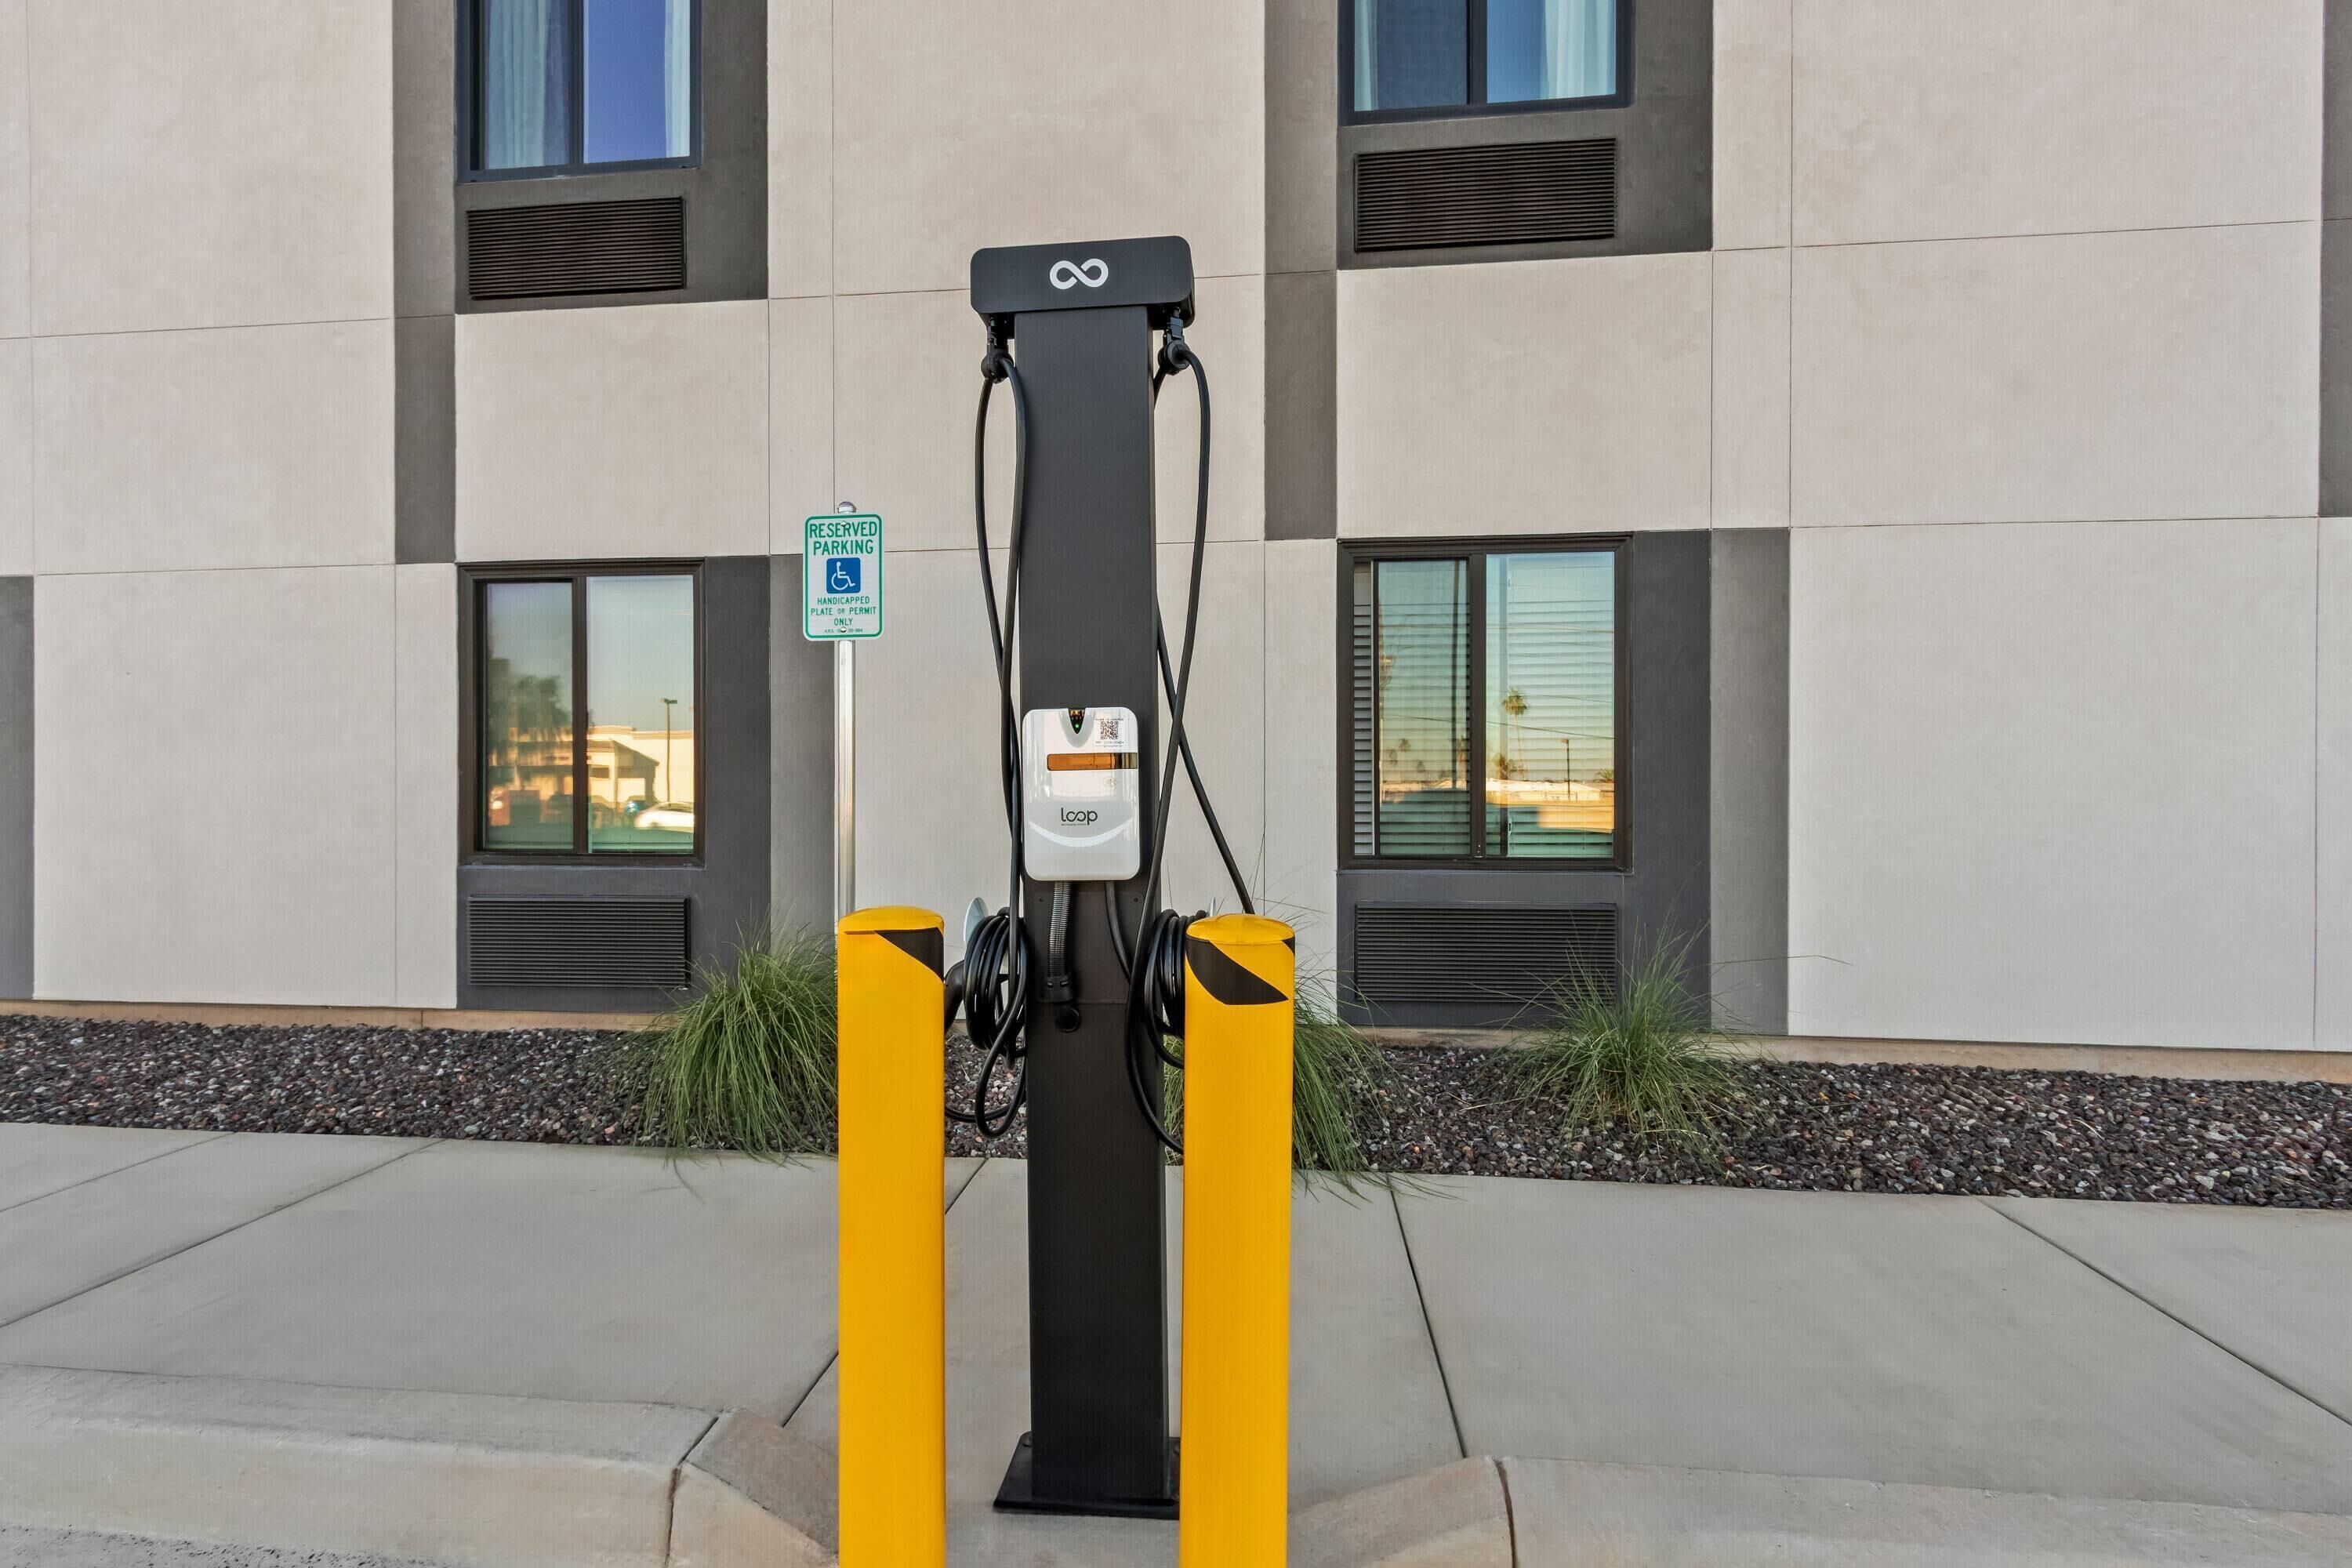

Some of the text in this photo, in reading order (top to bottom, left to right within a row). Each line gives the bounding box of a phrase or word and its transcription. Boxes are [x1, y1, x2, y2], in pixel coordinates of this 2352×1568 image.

[809, 521, 877, 539] RESERVED
[813, 539, 873, 556] PARKING
[817, 596, 869, 605] HANDICAPPED
